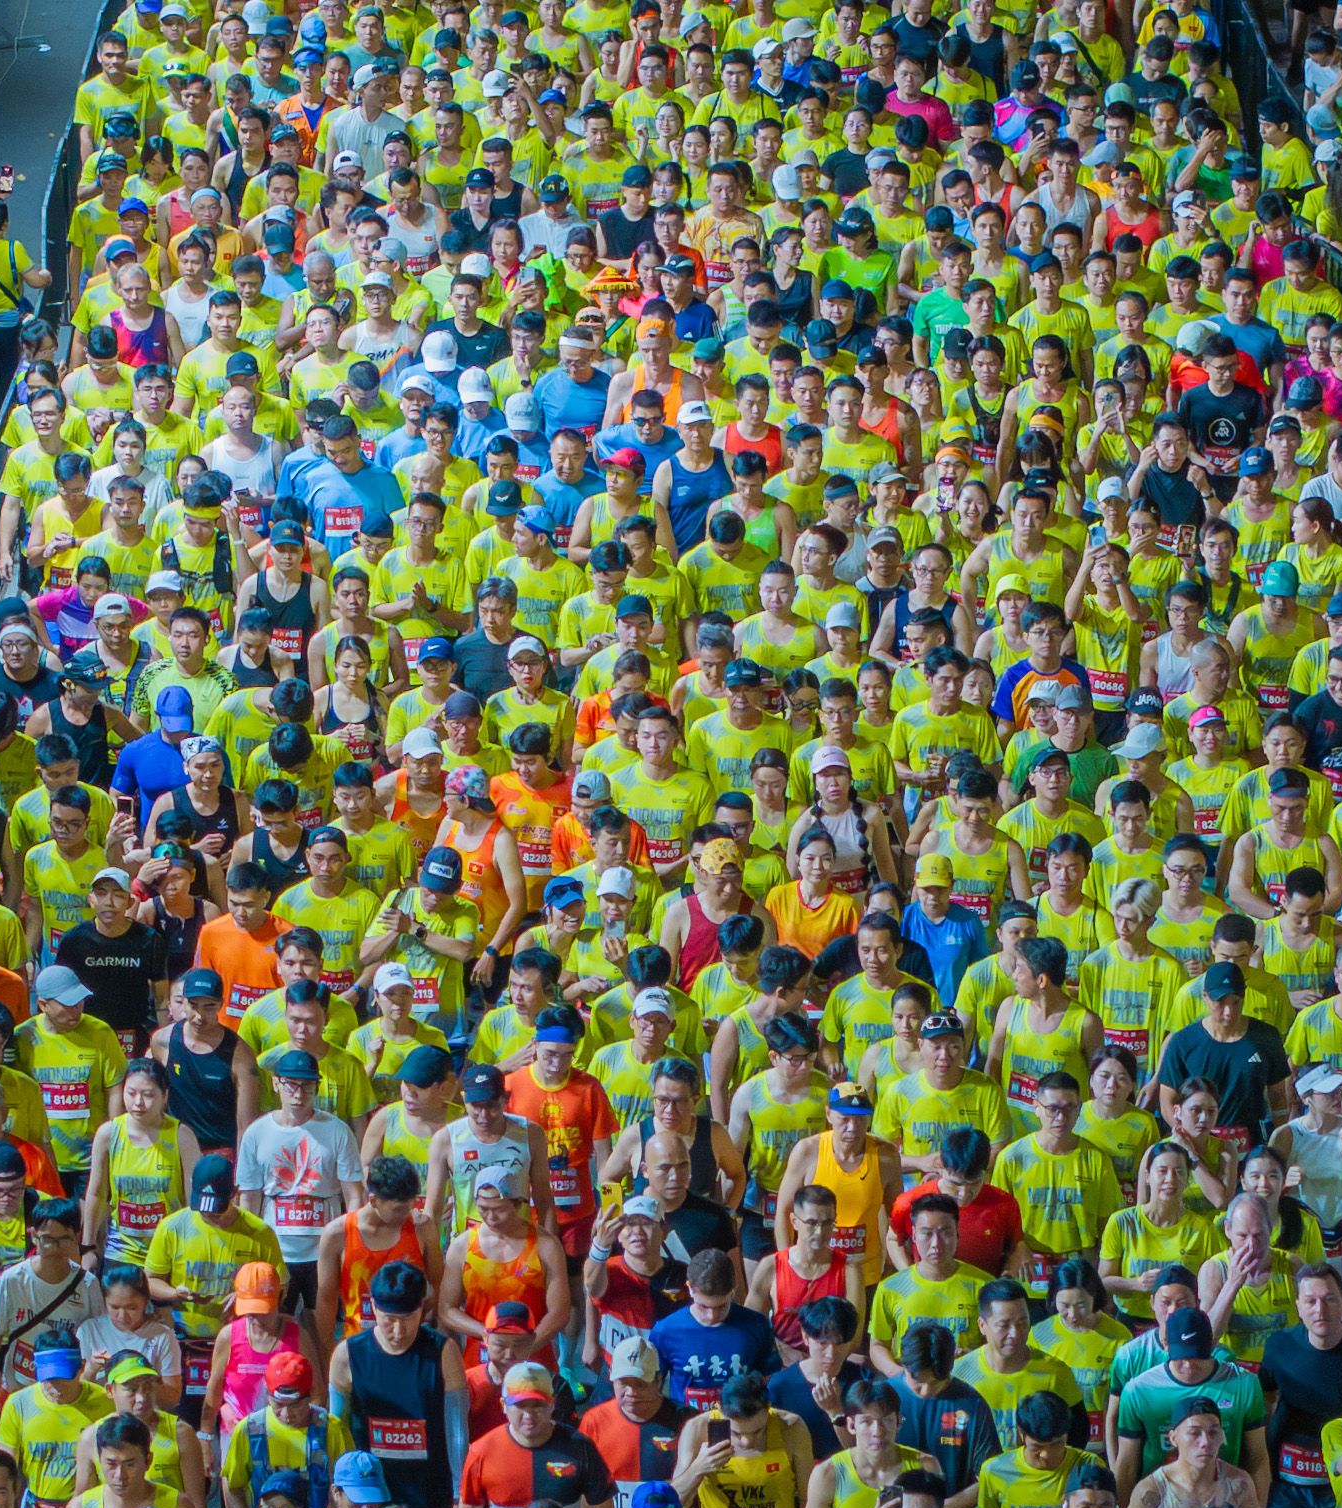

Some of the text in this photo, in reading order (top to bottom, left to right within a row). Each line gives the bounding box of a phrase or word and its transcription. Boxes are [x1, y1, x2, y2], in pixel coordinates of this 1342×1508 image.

[85, 956, 140, 968] GARMIN
[53, 1094, 85, 1105] 81498
[288, 1210, 320, 1221] 82176
[385, 1432, 421, 1444] 82262
